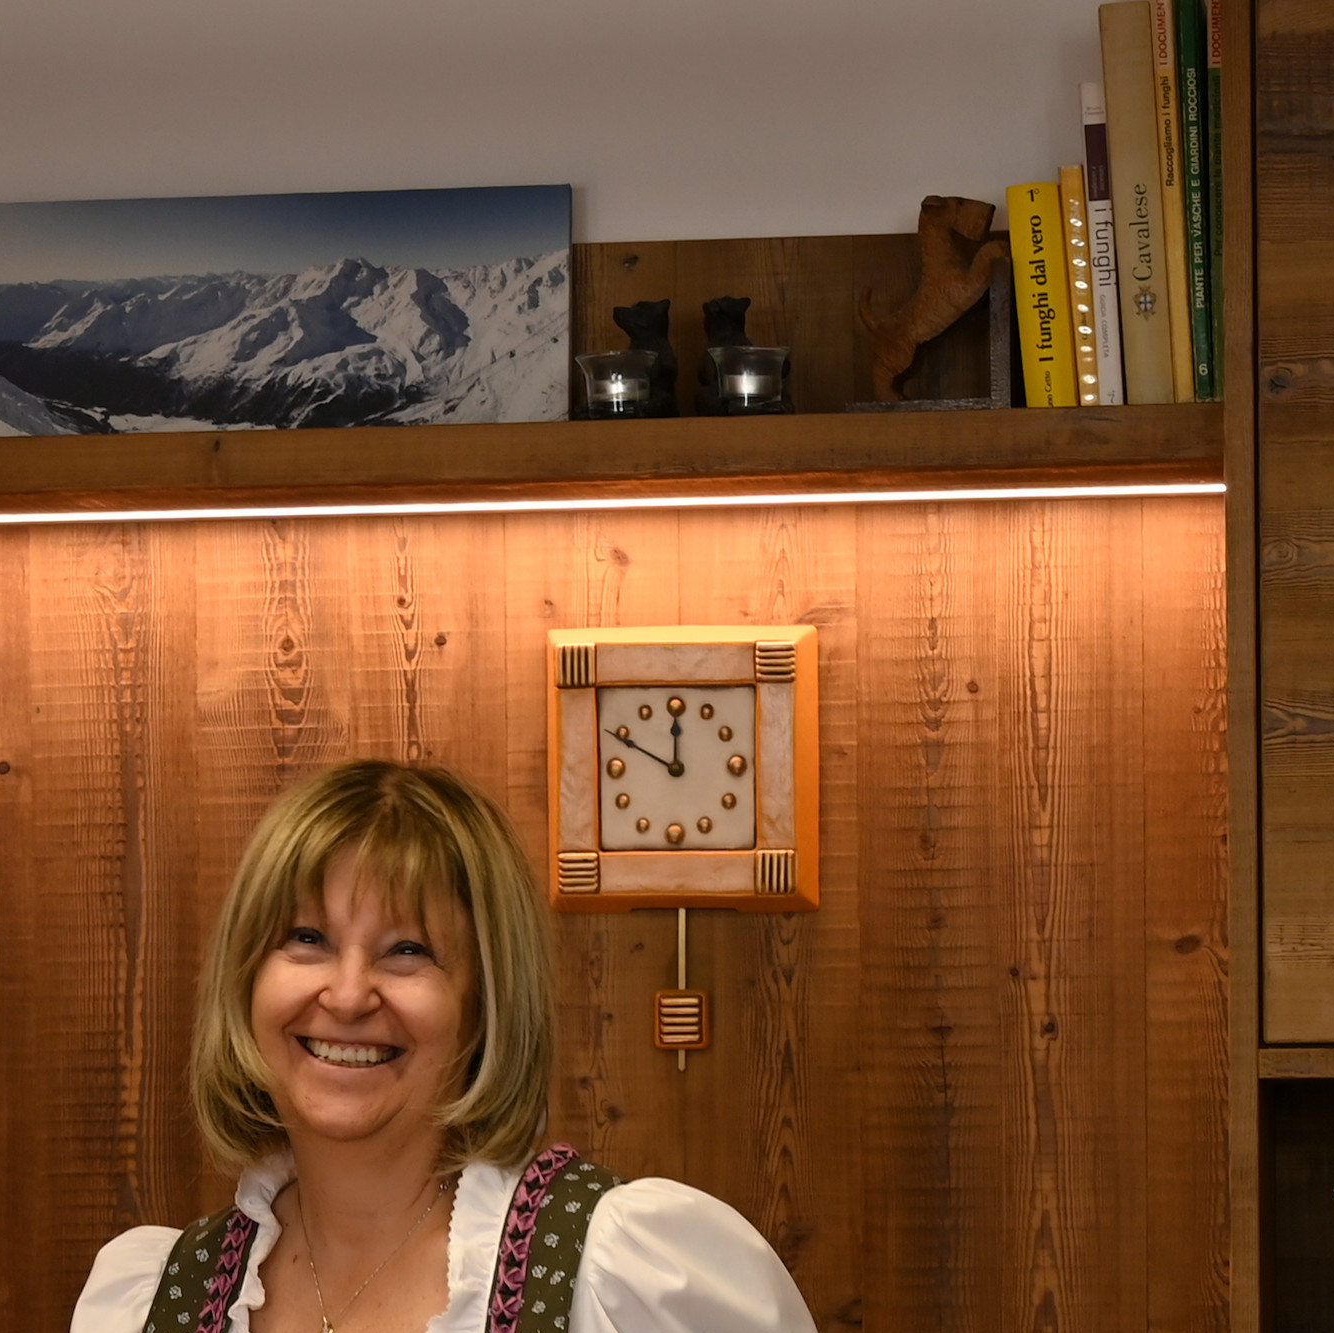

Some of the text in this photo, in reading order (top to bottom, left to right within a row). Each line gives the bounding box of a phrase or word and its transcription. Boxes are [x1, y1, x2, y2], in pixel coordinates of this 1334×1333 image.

[1160, 75, 1172, 109] funghi
[1163, 118, 1176, 187] Raccogliamo
[1186, 67, 1206, 309] PIANTE PER VASCHE E GIARDINI ROCCIOSI
[1030, 214, 1044, 252] vero
[1092, 220, 1118, 287] funghi
[1129, 183, 1152, 282] Cavalese
[1029, 256, 1049, 287] dal
[1032, 293, 1057, 351] funghi
[1100, 320, 1110, 358] COMPLETA
[1198, 363, 1209, 376] 6
